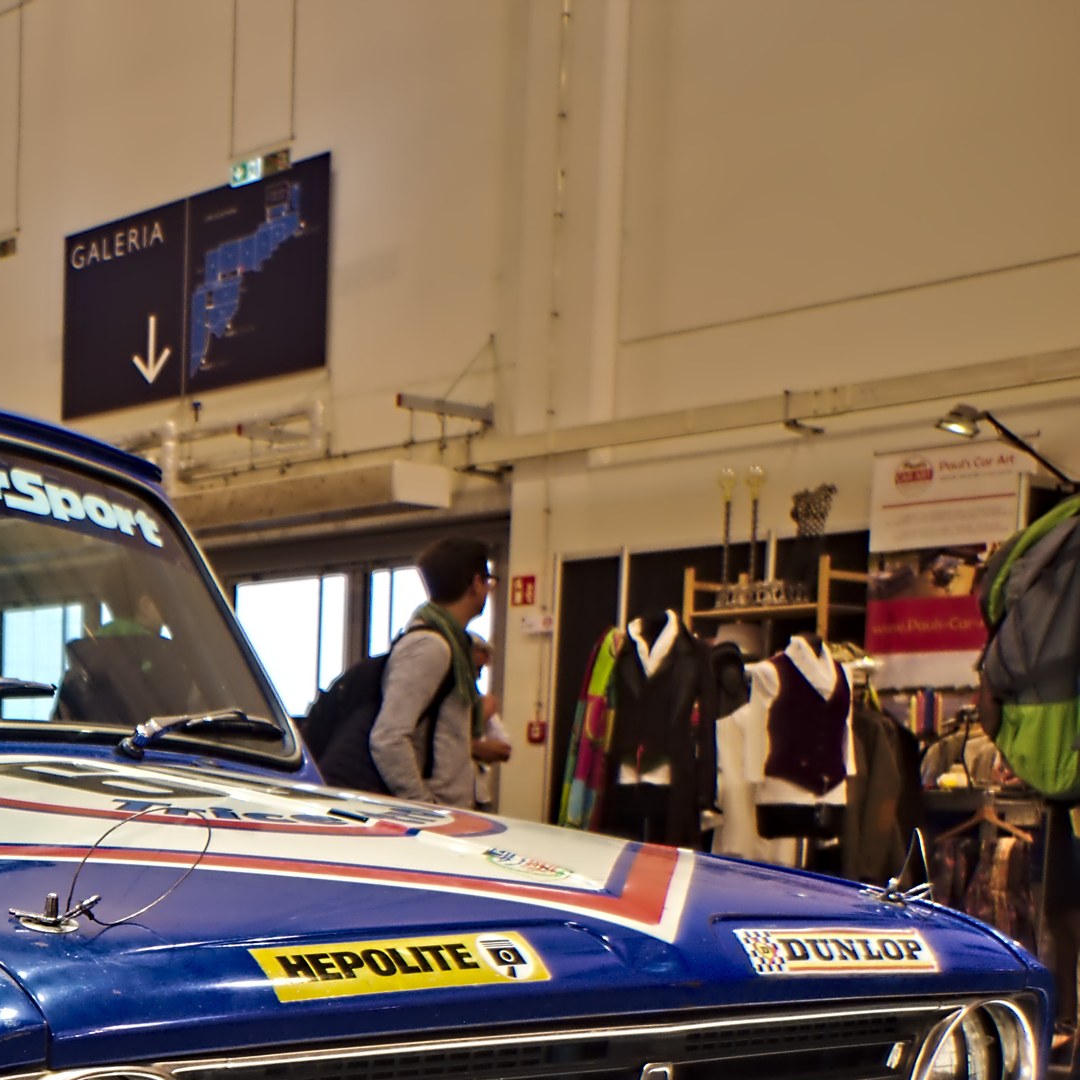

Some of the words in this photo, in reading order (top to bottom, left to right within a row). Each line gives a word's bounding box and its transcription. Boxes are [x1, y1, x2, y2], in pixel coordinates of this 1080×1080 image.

[71, 221, 164, 270] GALERIA
[274, 943, 481, 983] HEPOLITE
[777, 938, 922, 962] DUNLOP
